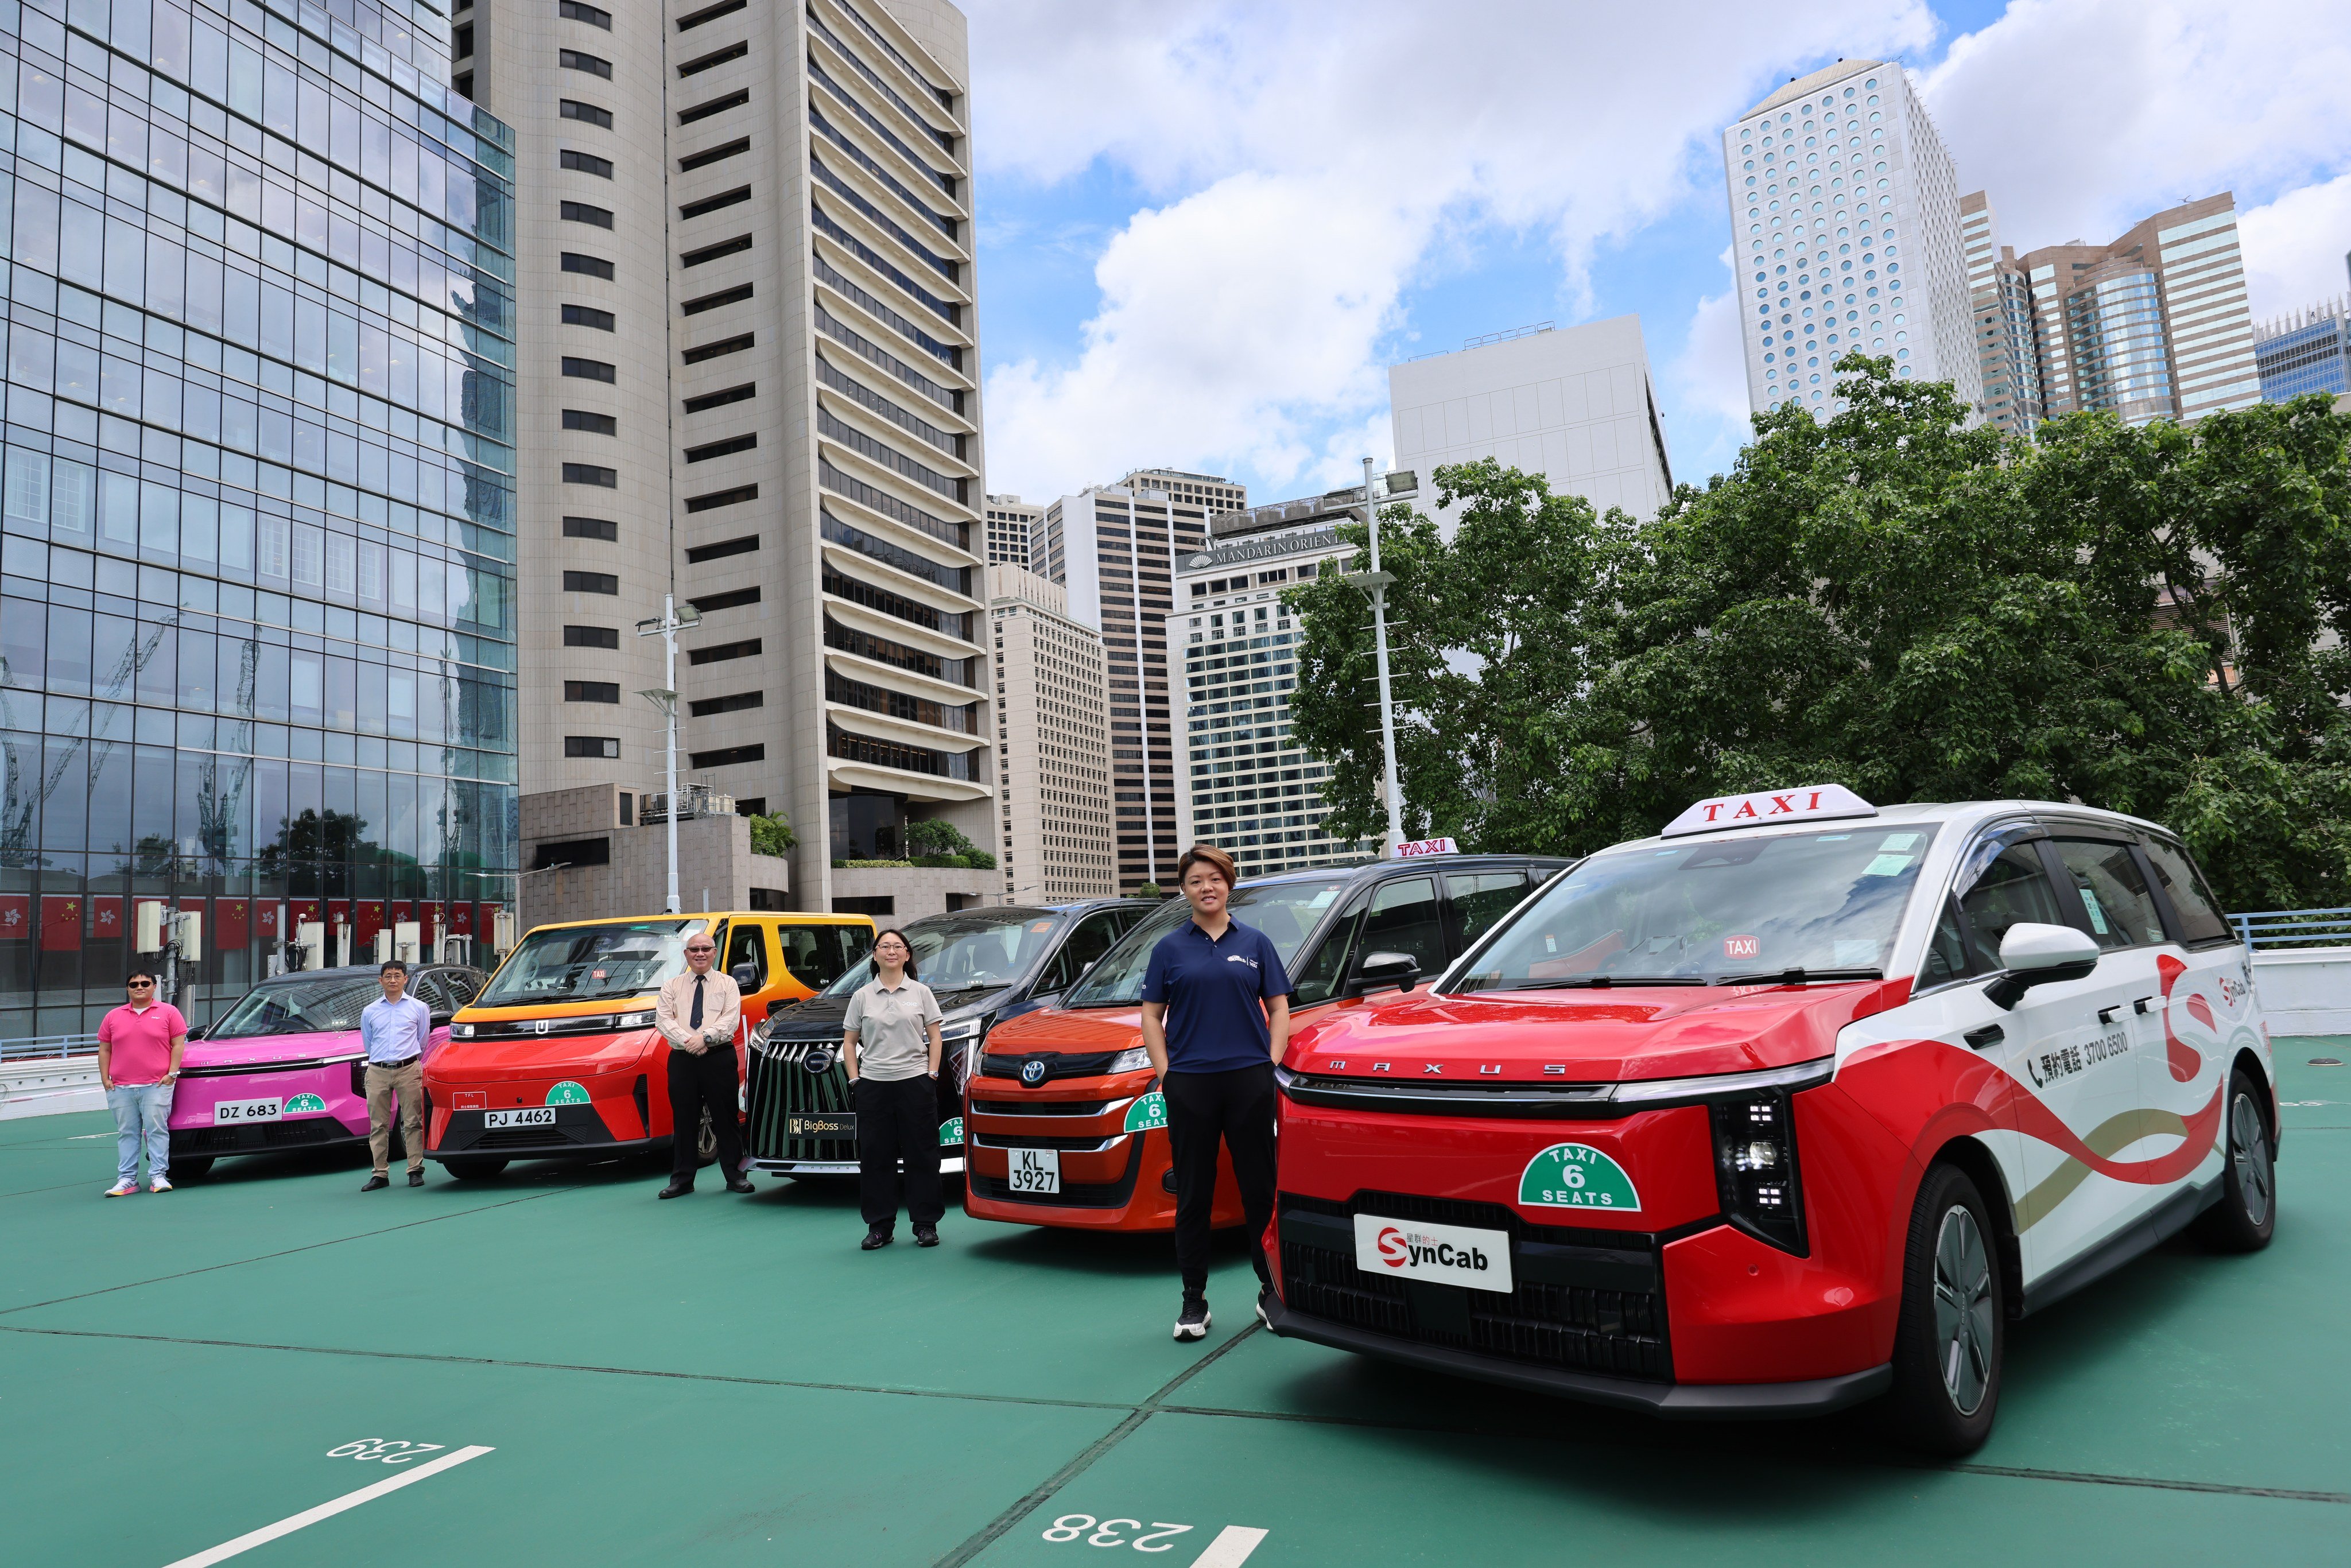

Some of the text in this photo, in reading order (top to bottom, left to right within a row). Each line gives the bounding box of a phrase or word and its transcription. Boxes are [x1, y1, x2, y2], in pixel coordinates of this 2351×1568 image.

[1216, 533, 1349, 564] MANDARIN ORIENTA
[1703, 792, 1822, 822] TAXI
[1398, 839, 1445, 856] TAXI
[1727, 940, 1756, 954] TAXI
[593, 970, 605, 978] TAXI
[200, 1053, 307, 1065] MAXUS
[2040, 1031, 2128, 1084] 預約電話 3700 6500
[1329, 1060, 1566, 1075] MAXUS
[564, 1089, 571, 1099] 6
[220, 1104, 277, 1119] DZ 683
[489, 1109, 552, 1127] PJ 4462
[1149, 1104, 1161, 1117] 6
[804, 1120, 839, 1133] BigBoss
[947, 1119, 963, 1127] TAX
[1138, 1117, 1167, 1128] SEAT
[953, 1125, 964, 1136] 6
[1022, 1151, 1044, 1171] KL
[1549, 1148, 1597, 1165] TAXI
[1013, 1170, 1055, 1191] 3927
[1562, 1165, 1585, 1188] 6
[1542, 1190, 1612, 1205] SEATS
[1406, 1233, 1438, 1246] 星群的士
[1378, 1227, 1488, 1271] SynCab
[326, 1438, 446, 1464] 239
[1042, 1514, 1194, 1552] 238
